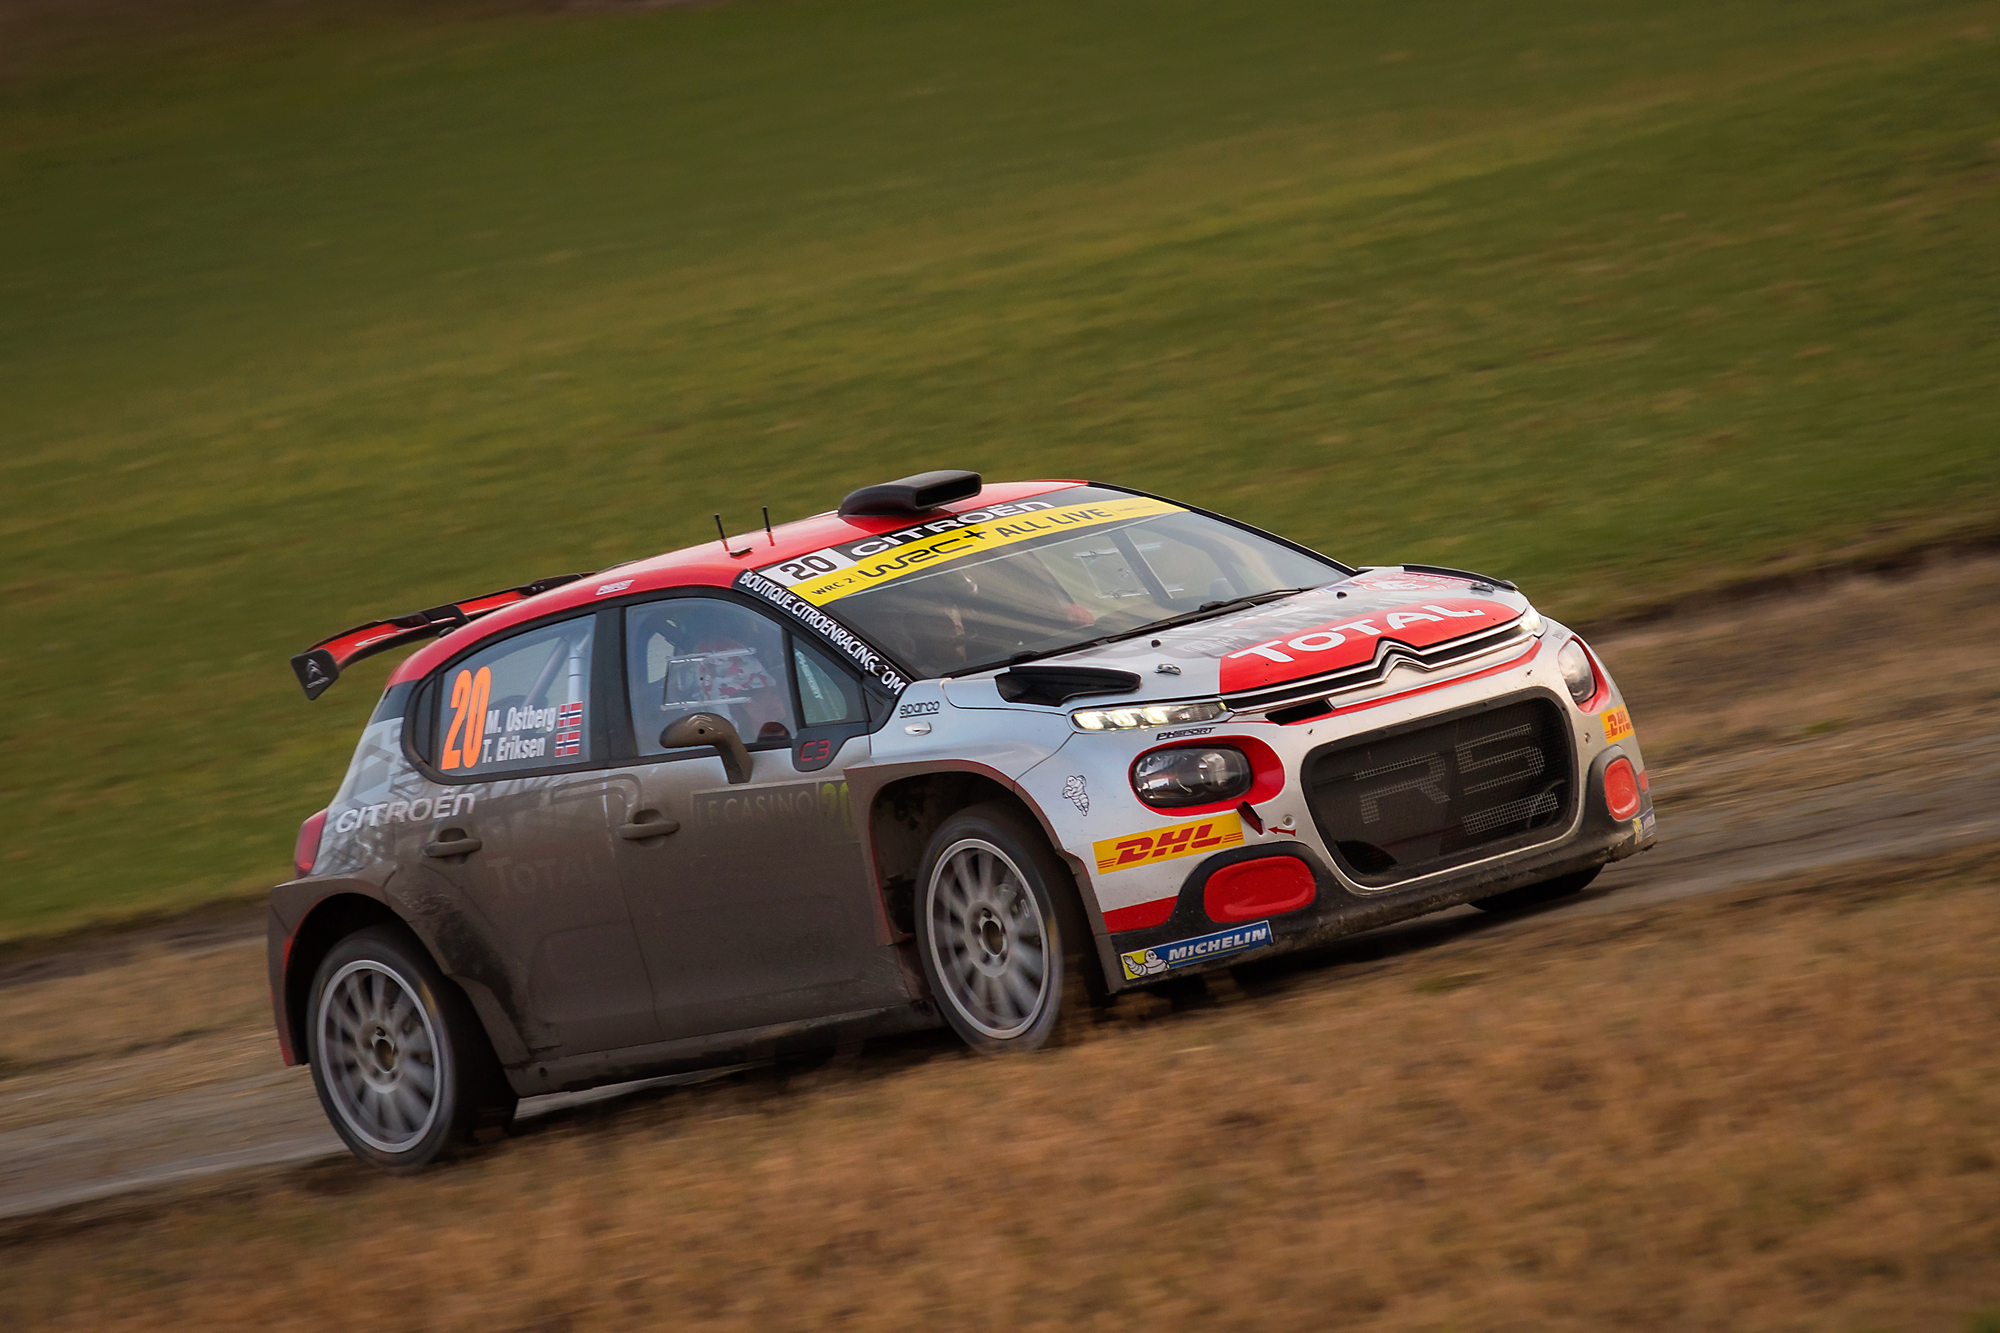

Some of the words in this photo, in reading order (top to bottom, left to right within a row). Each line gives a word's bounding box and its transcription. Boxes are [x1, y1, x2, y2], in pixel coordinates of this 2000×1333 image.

[995, 519, 1052, 538] ALL
[1046, 508, 1114, 525] LIVE
[779, 555, 838, 581] 20
[811, 581, 845, 596] WRC
[1228, 604, 1485, 664] TOTAL
[441, 666, 491, 770] 20
[484, 709, 502, 735] M.
[506, 704, 557, 732] Ostberg
[900, 701, 940, 717] sparco
[482, 738, 493, 764] T.
[495, 735, 546, 762] Eriksen
[800, 739, 831, 761] C3
[1114, 823, 1222, 865] DHL
[1168, 928, 1267, 961] MICHELIN
